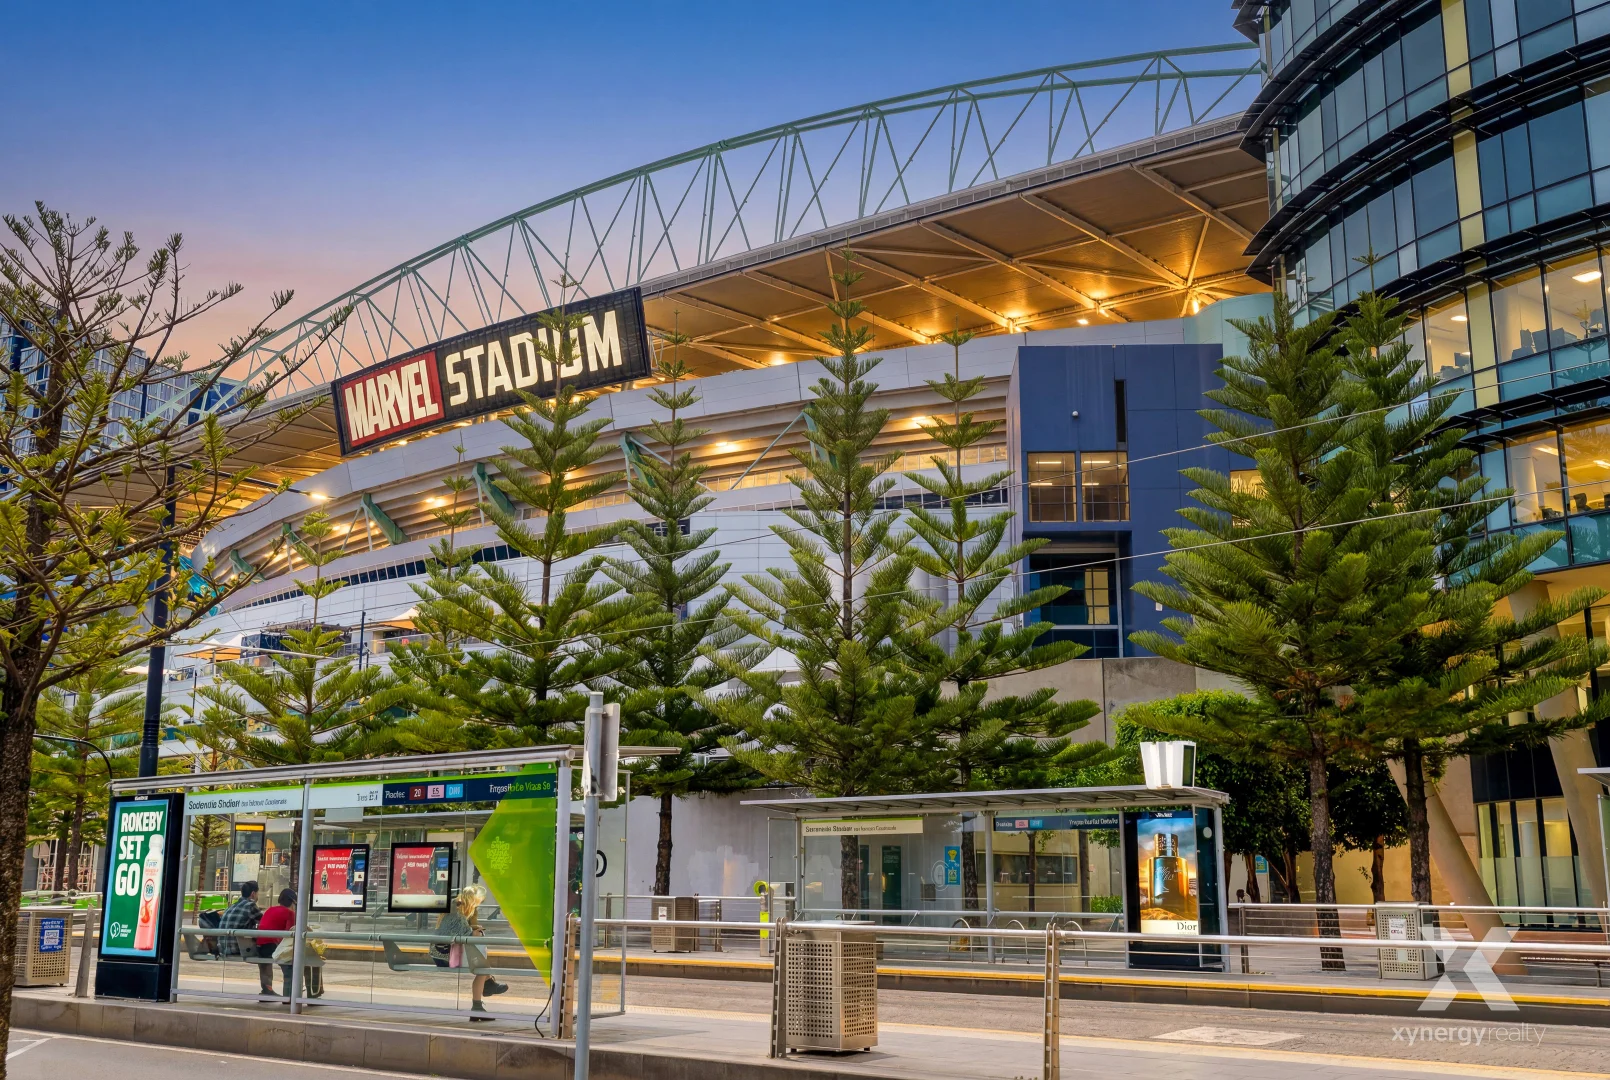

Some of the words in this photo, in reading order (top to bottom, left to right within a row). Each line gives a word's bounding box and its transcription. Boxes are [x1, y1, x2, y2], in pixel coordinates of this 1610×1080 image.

[344, 359, 439, 441] MARVEL
[445, 310, 622, 406] STADIUM
[121, 811, 164, 832] ROKEBY
[118, 835, 145, 860] SET
[115, 863, 141, 897] GO
[1176, 921, 1197, 931] Dior
